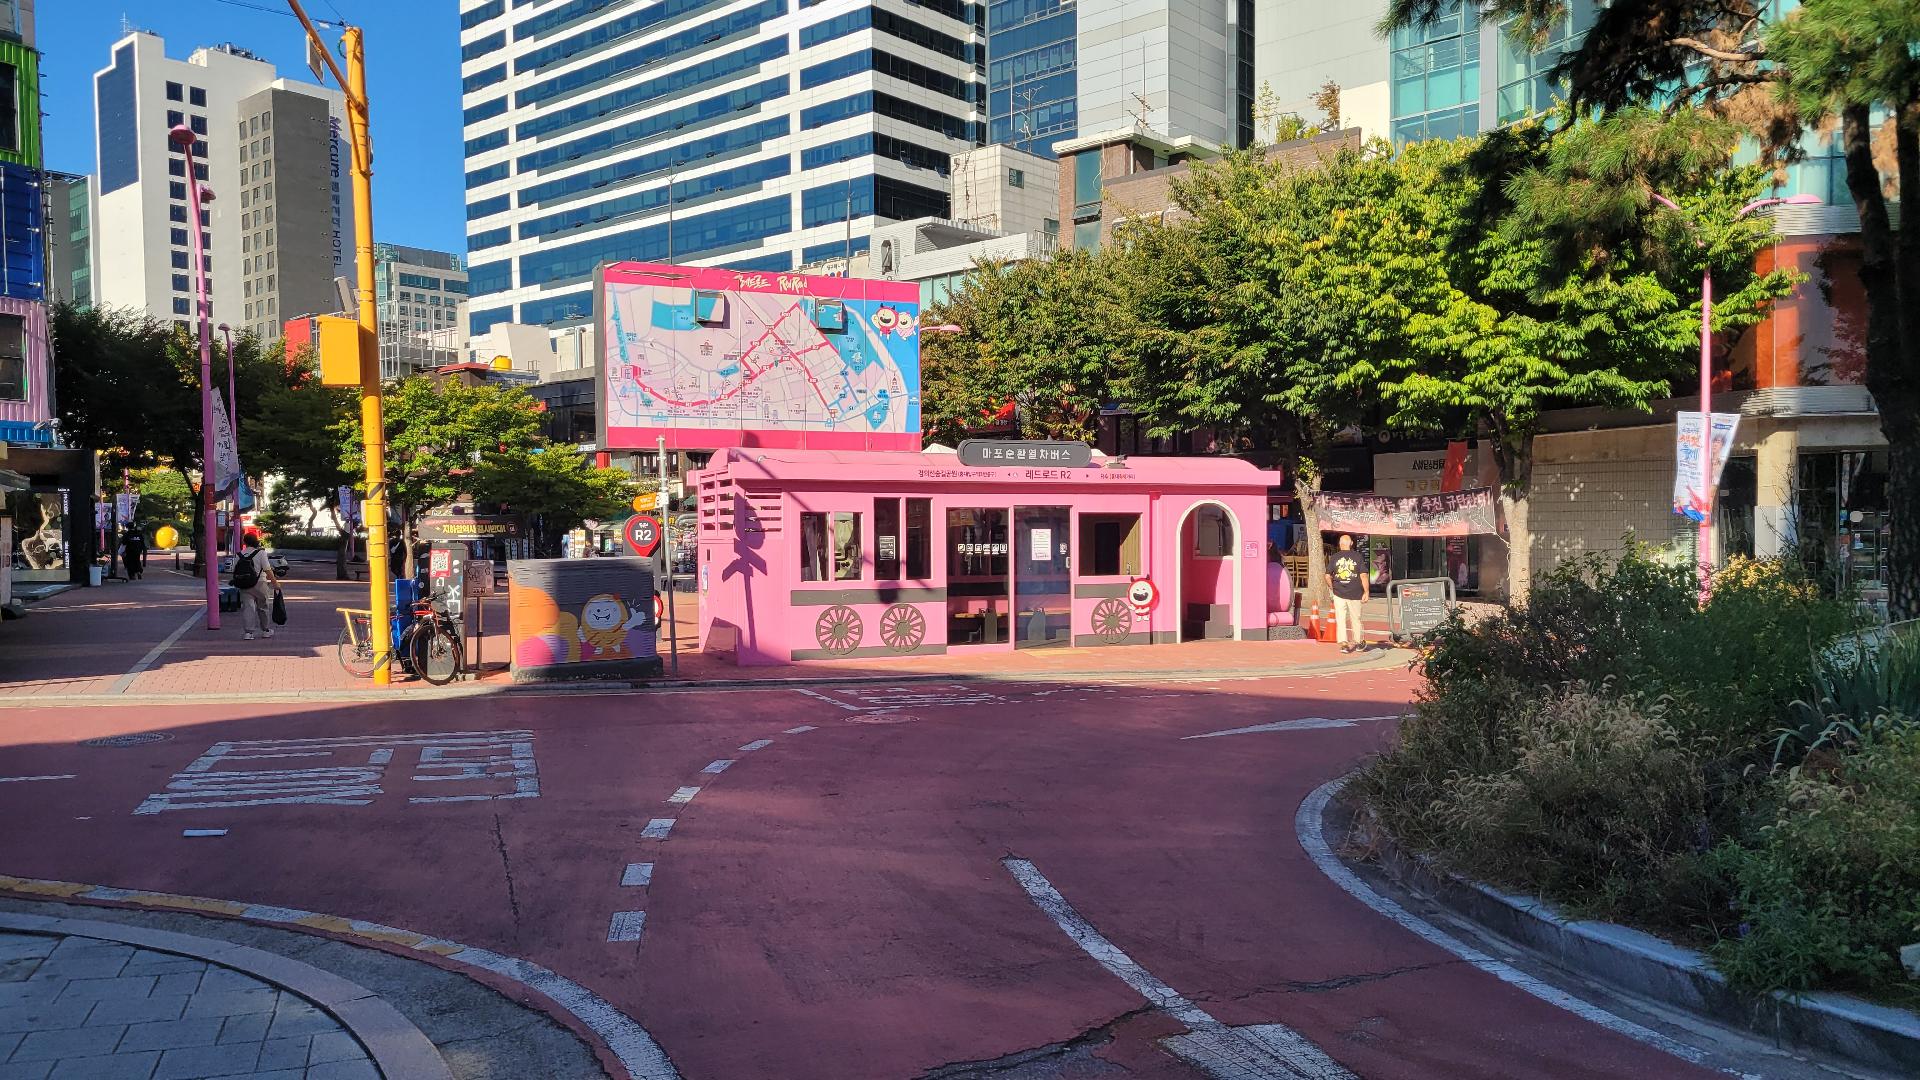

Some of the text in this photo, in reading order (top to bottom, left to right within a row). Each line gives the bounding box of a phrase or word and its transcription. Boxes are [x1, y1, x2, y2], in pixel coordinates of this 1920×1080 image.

[330, 116, 341, 178] Mercure
[332, 230, 342, 269] HOTEL
[982, 447, 1071, 460] 마포순환열차버스
[1026, 470, 1071, 480] 레드로드 R2
[1421, 496, 1444, 511] 추진
[635, 529, 652, 541] R2
